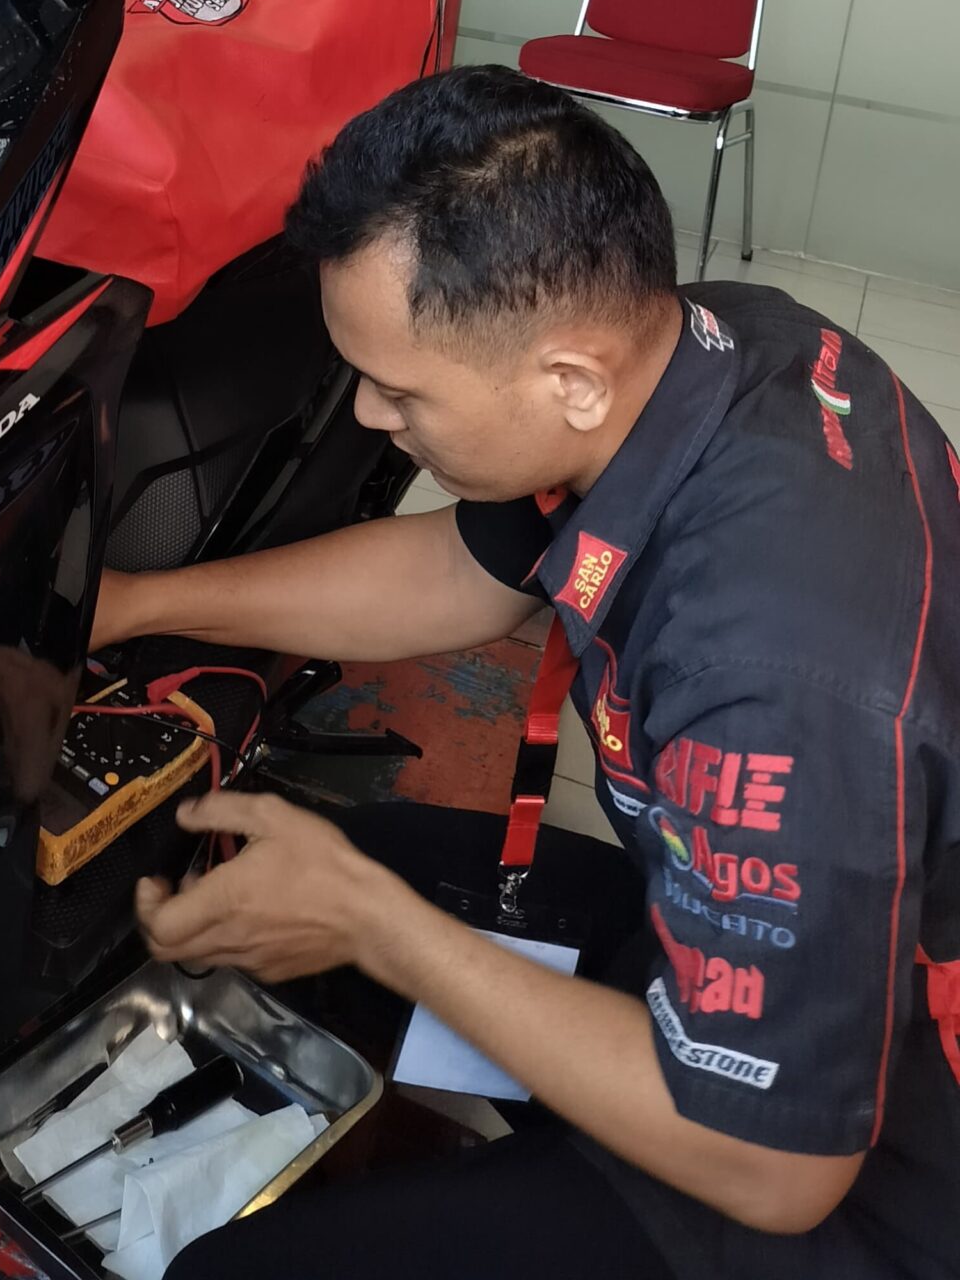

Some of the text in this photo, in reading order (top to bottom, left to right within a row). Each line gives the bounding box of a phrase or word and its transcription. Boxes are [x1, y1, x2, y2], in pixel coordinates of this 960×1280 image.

[574, 552, 599, 593] SAN
[579, 550, 613, 609] CARLO
[692, 824, 803, 902] Agos
